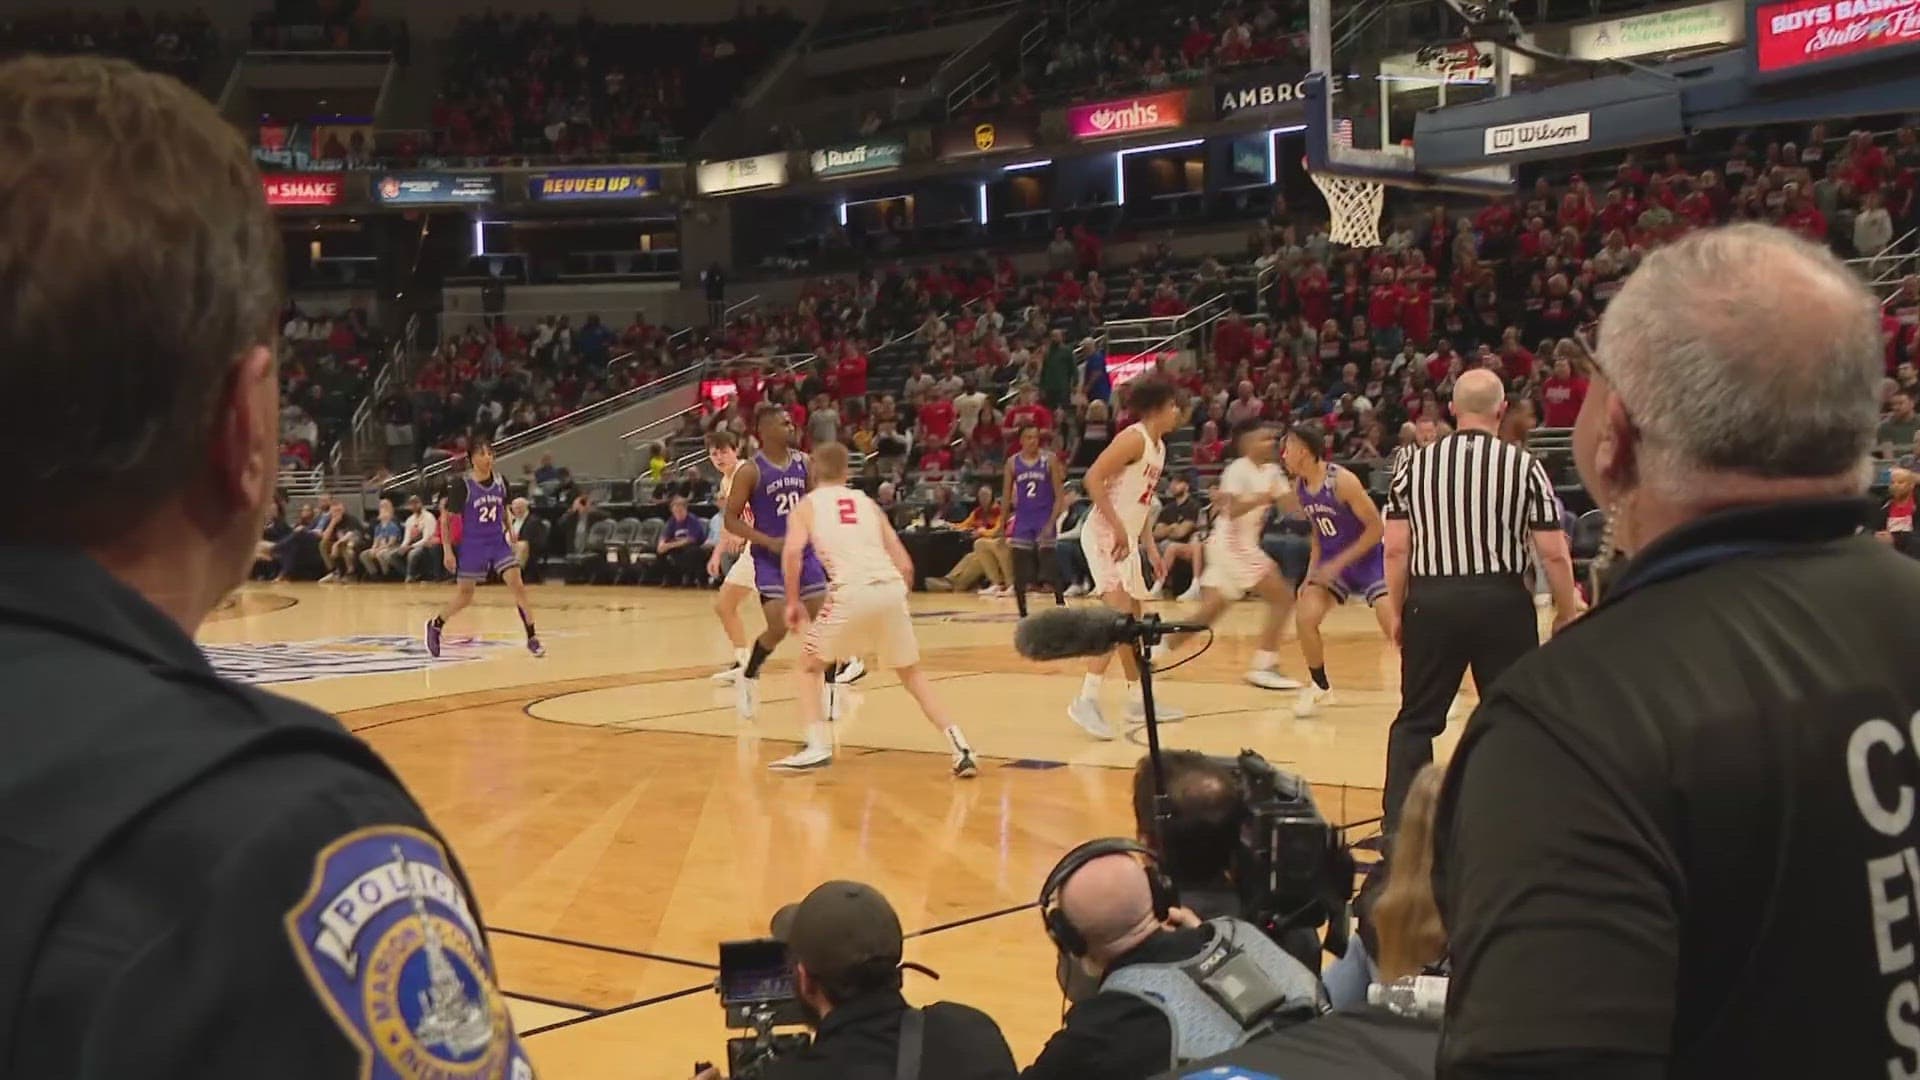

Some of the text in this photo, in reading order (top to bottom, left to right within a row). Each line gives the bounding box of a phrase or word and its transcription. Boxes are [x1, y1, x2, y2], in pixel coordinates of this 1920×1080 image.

[1772, 4, 1832, 34] BOYS
[1805, 17, 1869, 53] State
[1115, 101, 1158, 129] mhs
[1518, 124, 1577, 143] Wilson
[828, 145, 867, 166] Ruoff
[280, 182, 336, 197] SHAKE
[543, 176, 631, 193] REVVED UP
[1025, 481, 1037, 497] 2
[479, 506, 497, 522] 24
[837, 498, 858, 524] 2
[1316, 517, 1338, 537] 10
